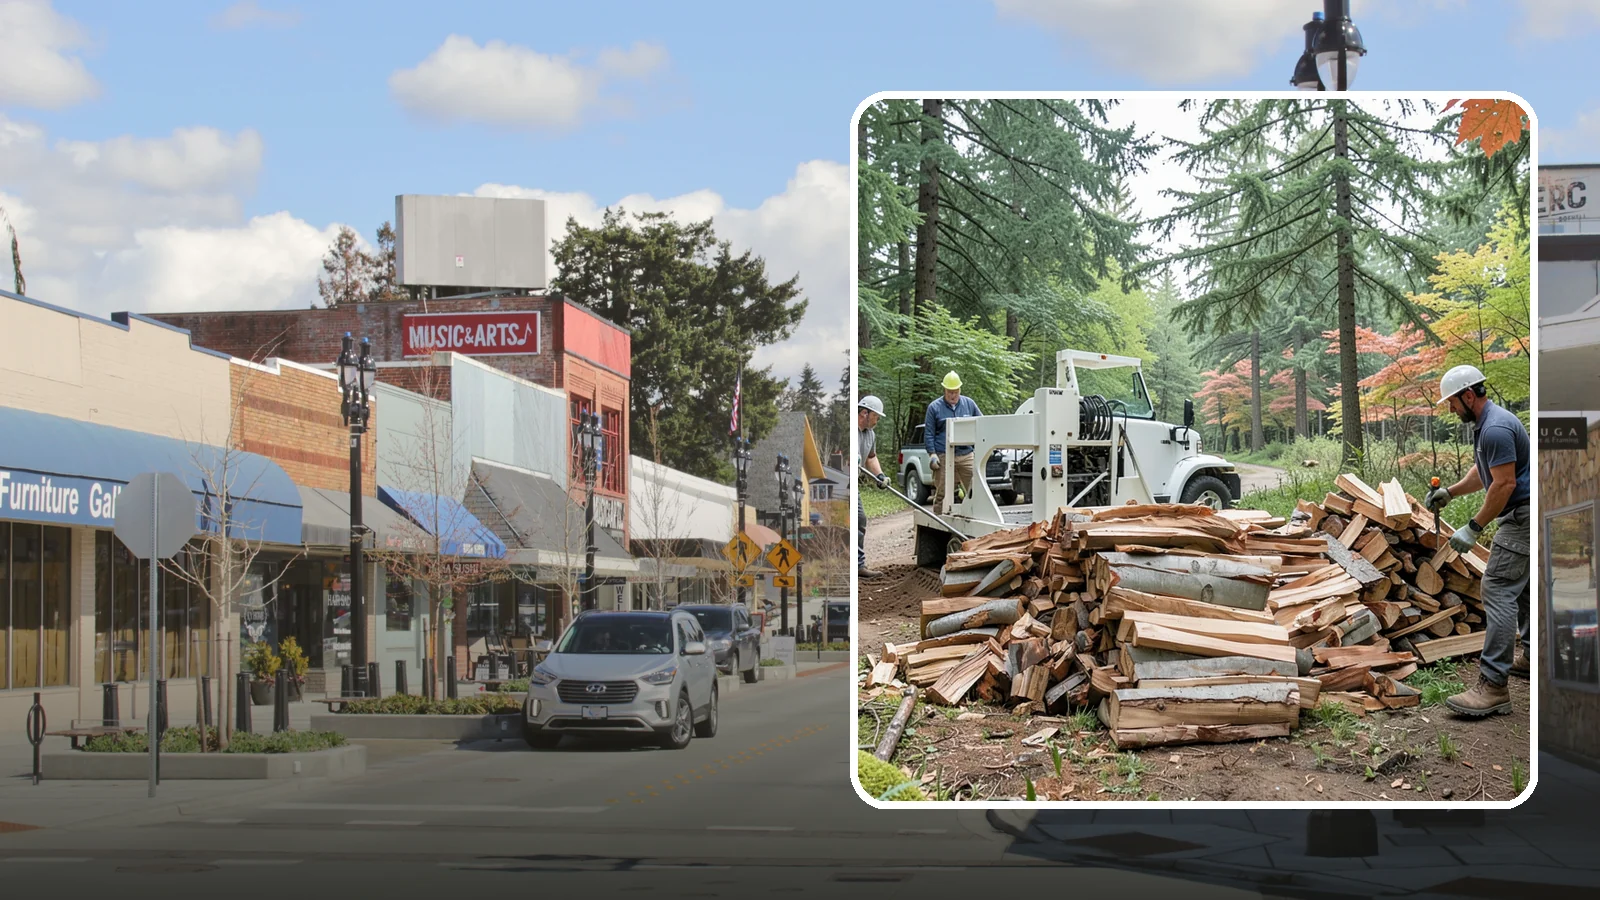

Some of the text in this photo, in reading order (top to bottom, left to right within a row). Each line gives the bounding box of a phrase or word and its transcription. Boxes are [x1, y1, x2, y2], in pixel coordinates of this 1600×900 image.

[1538, 181, 1586, 213] ERC
[1540, 427, 1578, 436] UGA
[0, 471, 121, 519] Furniture Gal
[453, 563, 479, 574] SUSHI
